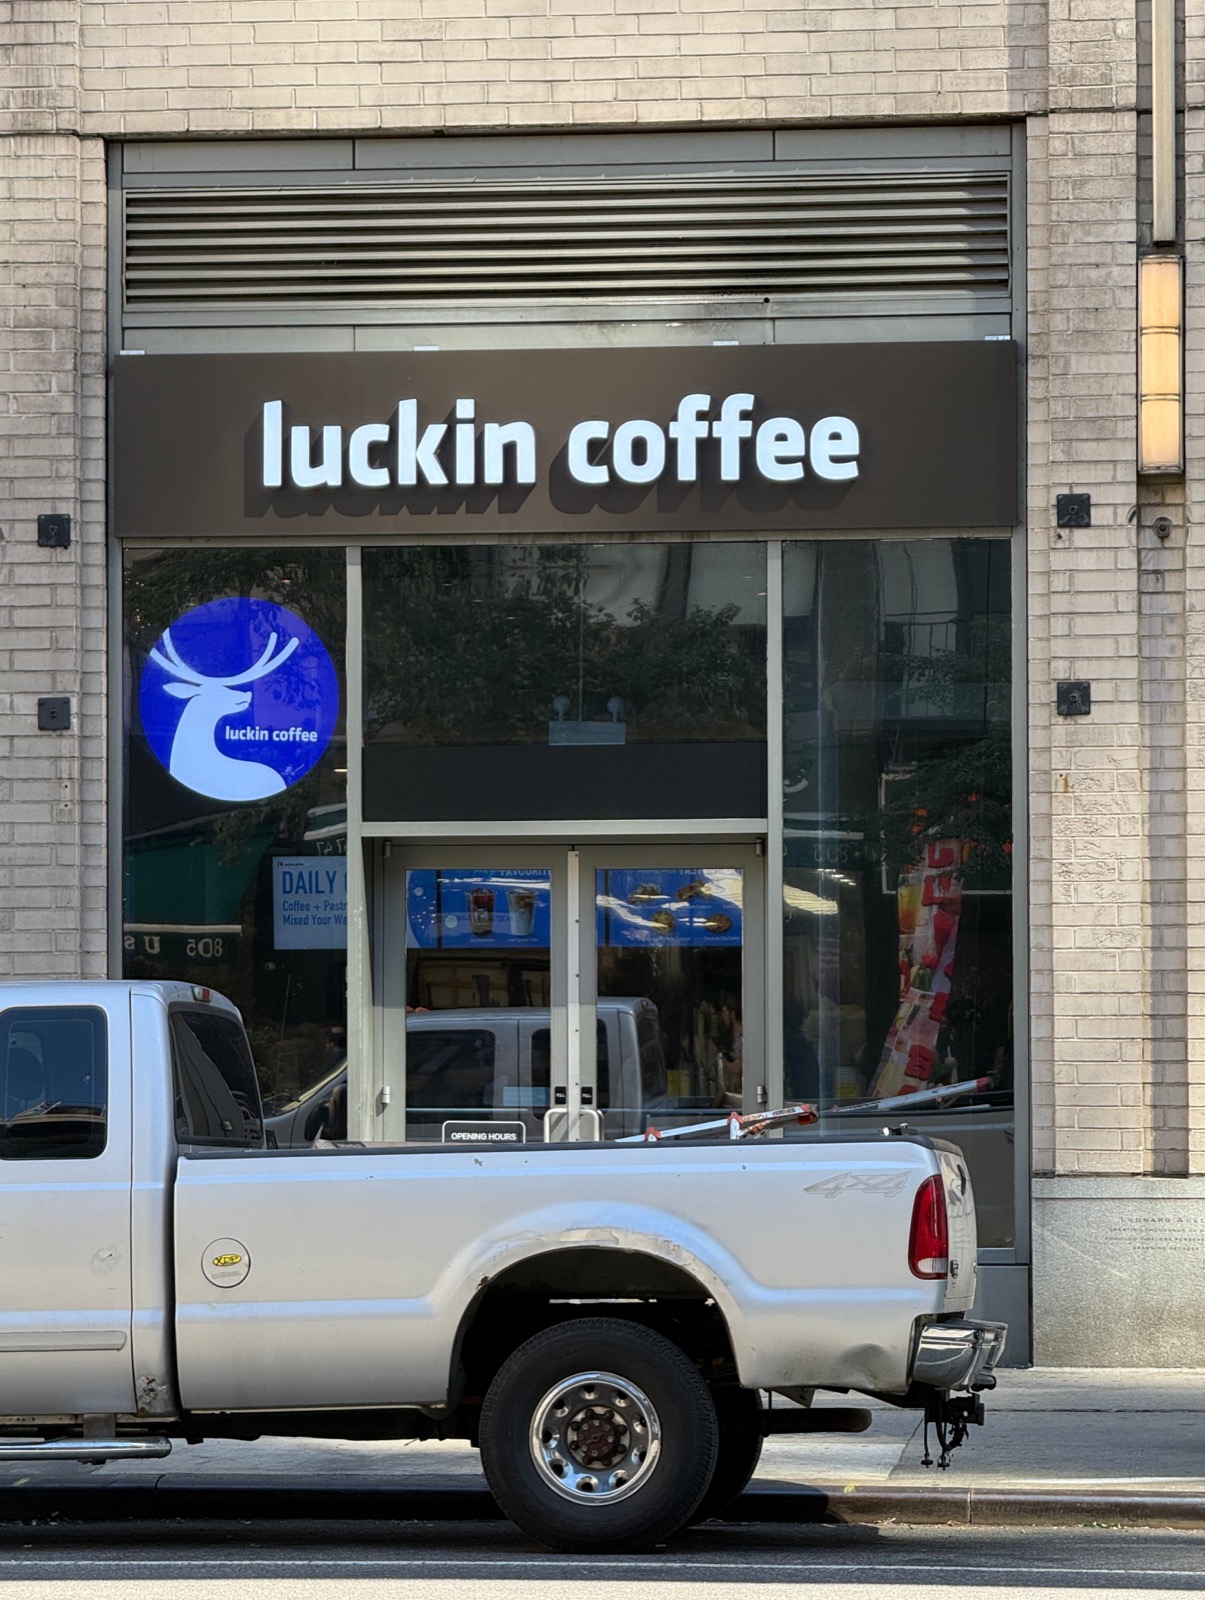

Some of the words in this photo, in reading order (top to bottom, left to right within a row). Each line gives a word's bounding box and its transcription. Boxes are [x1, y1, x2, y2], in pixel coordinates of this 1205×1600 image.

[263, 398, 537, 487] luckin
[567, 393, 860, 485] coffee
[225, 725, 269, 741] luckin
[272, 727, 318, 742] coffee
[281, 870, 337, 895] DAILY
[282, 900, 312, 912] Coffee
[282, 914, 309, 926] Mixed
[311, 914, 332, 925] Your
[450, 1132, 487, 1141] OPENING
[488, 1132, 517, 1141] HOURS
